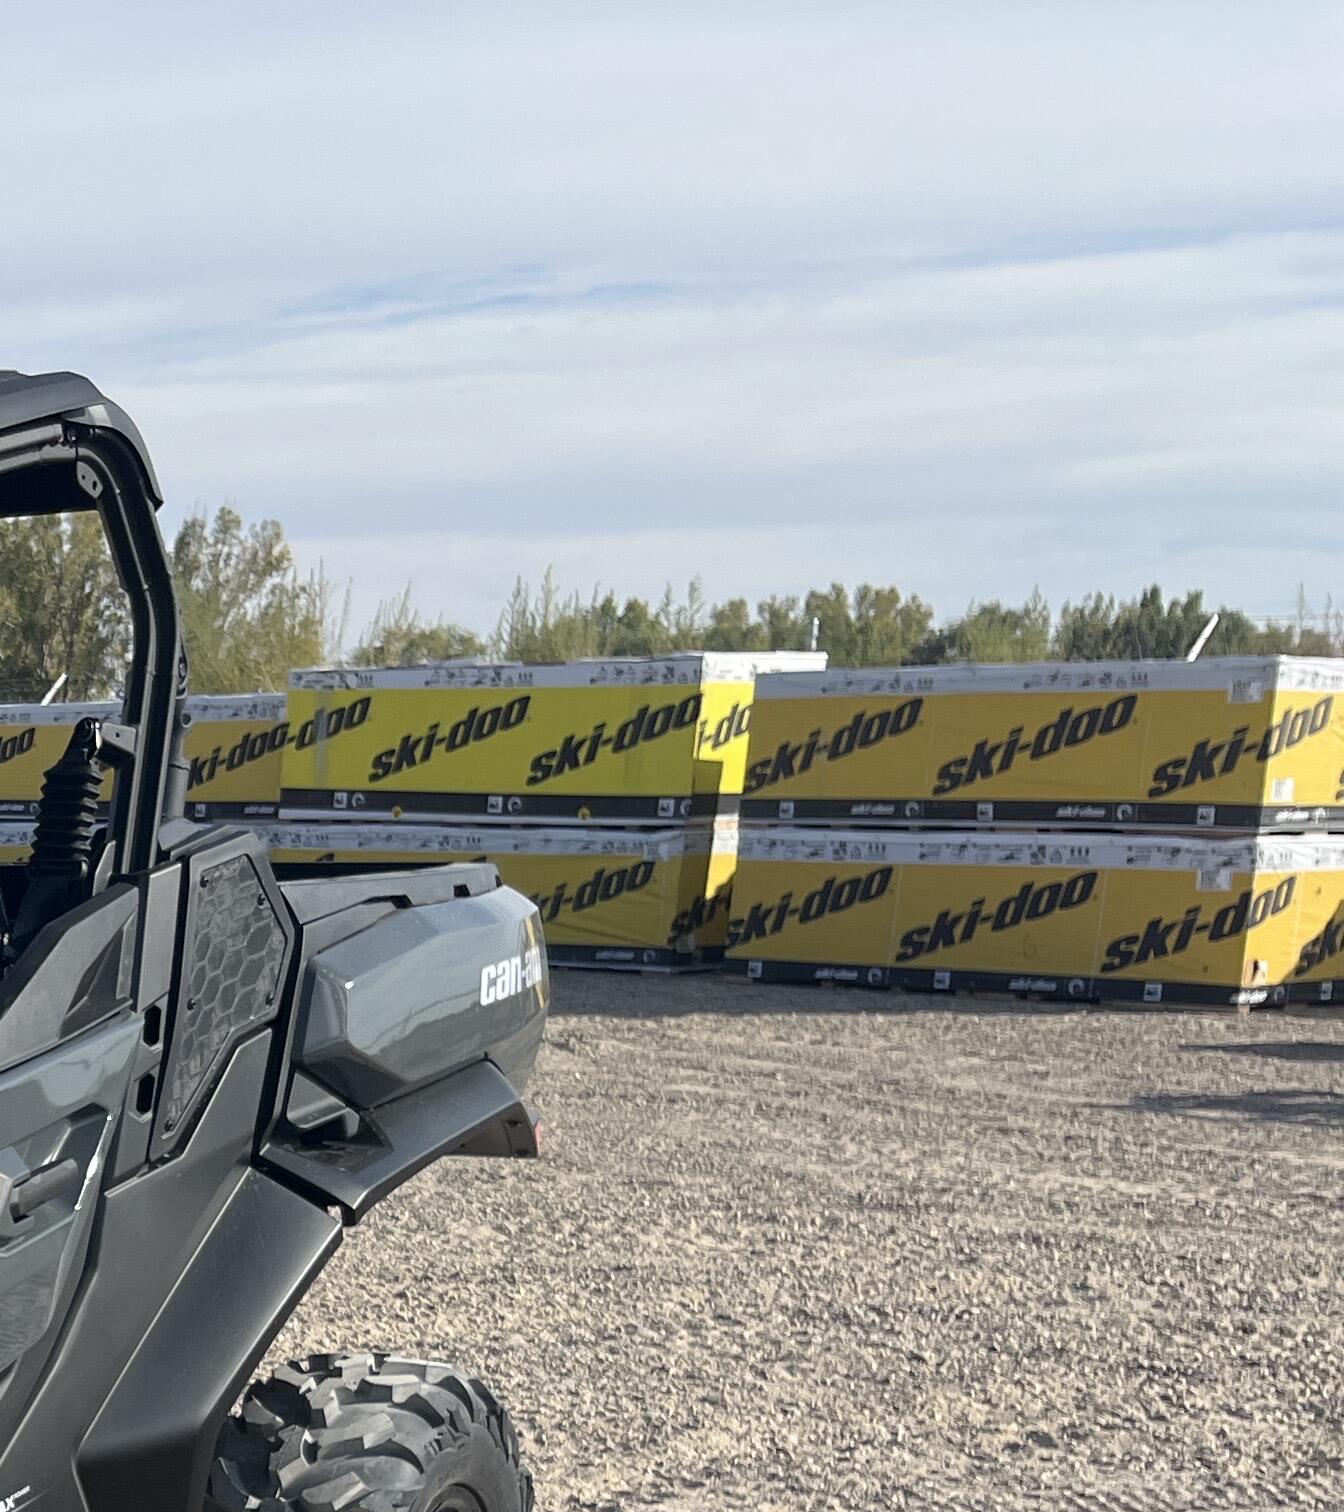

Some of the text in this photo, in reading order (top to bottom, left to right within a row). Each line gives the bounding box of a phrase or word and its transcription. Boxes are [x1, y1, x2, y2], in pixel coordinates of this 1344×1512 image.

[368, 696, 531, 783] ski-doo
[526, 694, 703, 786] ski-doo
[744, 699, 924, 794] ski-doo
[933, 694, 1138, 797] ski-doo
[1148, 696, 1334, 799] ski-doo
[725, 866, 894, 946] ski-doo
[895, 870, 1097, 962] ski-doo
[1100, 875, 1297, 972] ski-doo
